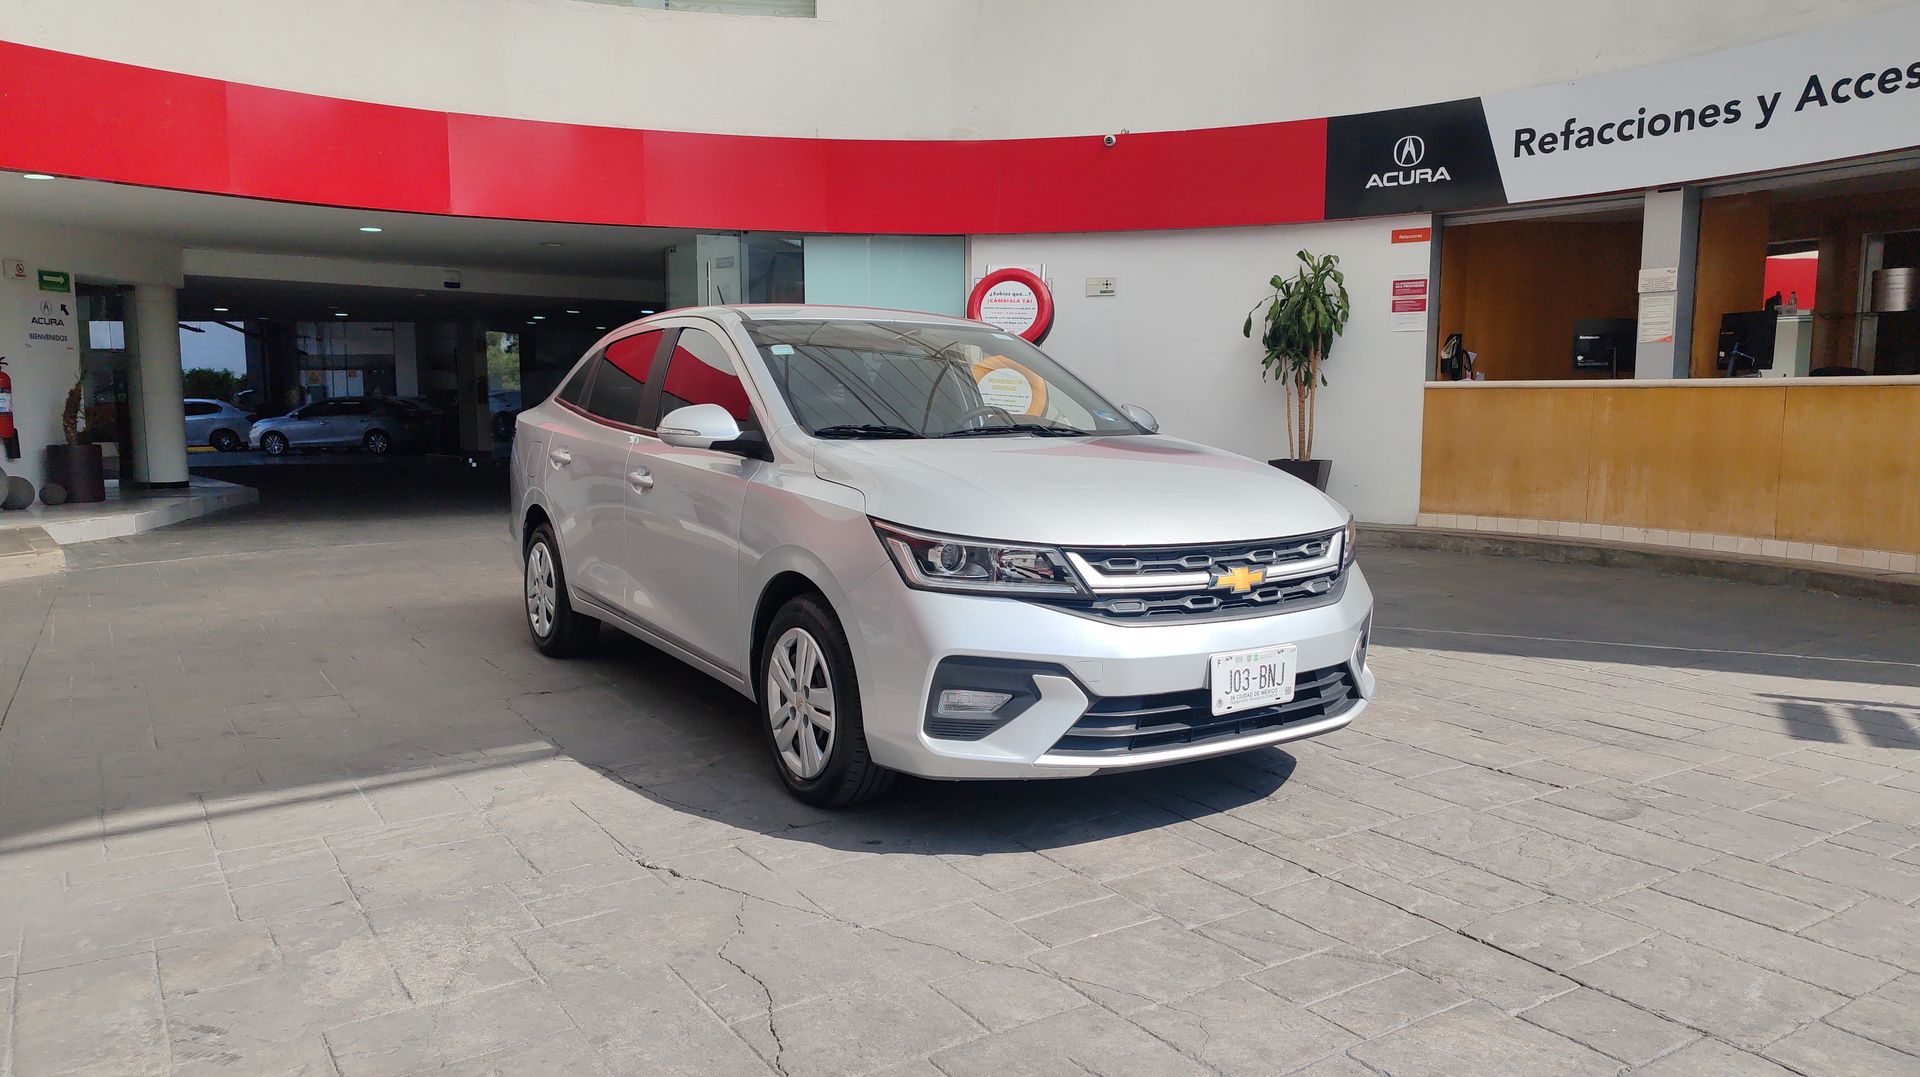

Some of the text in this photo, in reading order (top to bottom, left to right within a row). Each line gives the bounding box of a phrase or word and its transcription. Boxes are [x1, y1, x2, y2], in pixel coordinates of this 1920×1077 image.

[1513, 61, 1920, 158] Refacciones y Acces
[1365, 165, 1452, 189] ACURA
[31, 317, 65, 326] ACURA
[29, 333, 68, 342] BIENVENIDOS
[1224, 662, 1285, 695] J03-BNJ
[1236, 692, 1253, 700] CIUDAD
